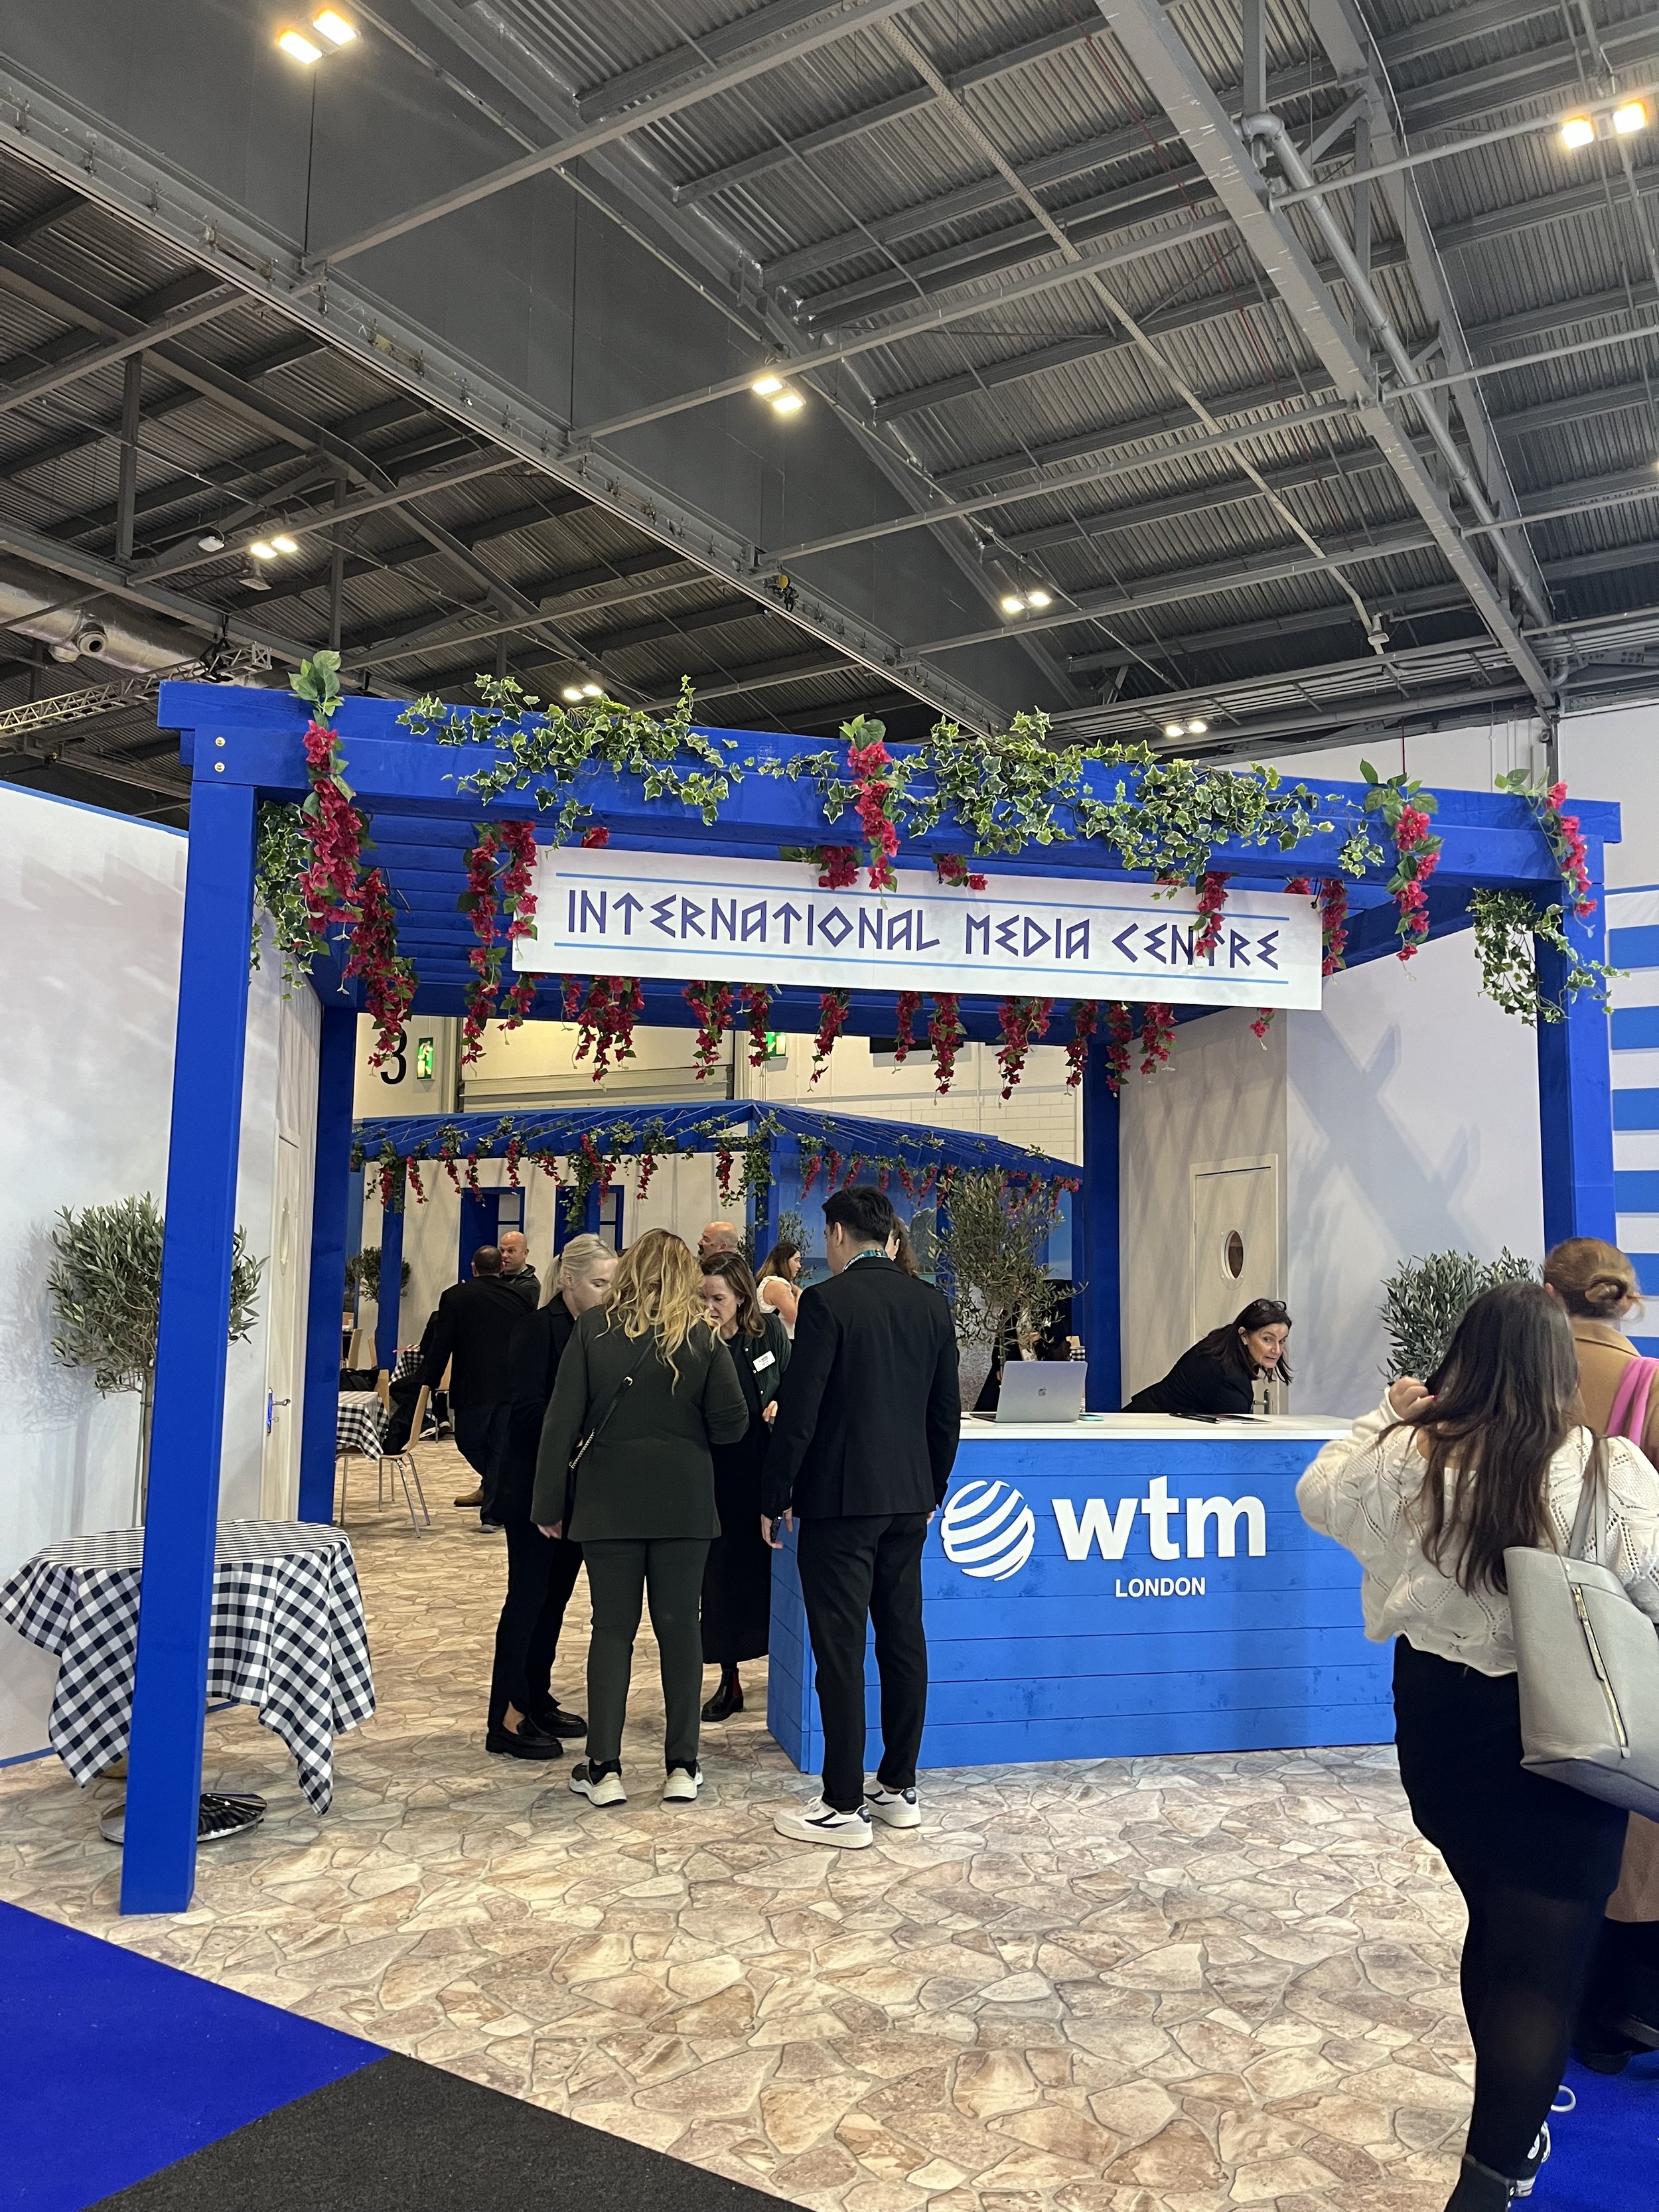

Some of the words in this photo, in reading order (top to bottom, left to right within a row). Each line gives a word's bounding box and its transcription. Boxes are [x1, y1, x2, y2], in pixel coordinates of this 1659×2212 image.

[568, 889, 940, 952] INTERNATIONAL
[966, 913, 1090, 960] MEDIA
[1051, 1475, 1266, 1561] wtm
[1116, 1577, 1206, 1597] LONDON
